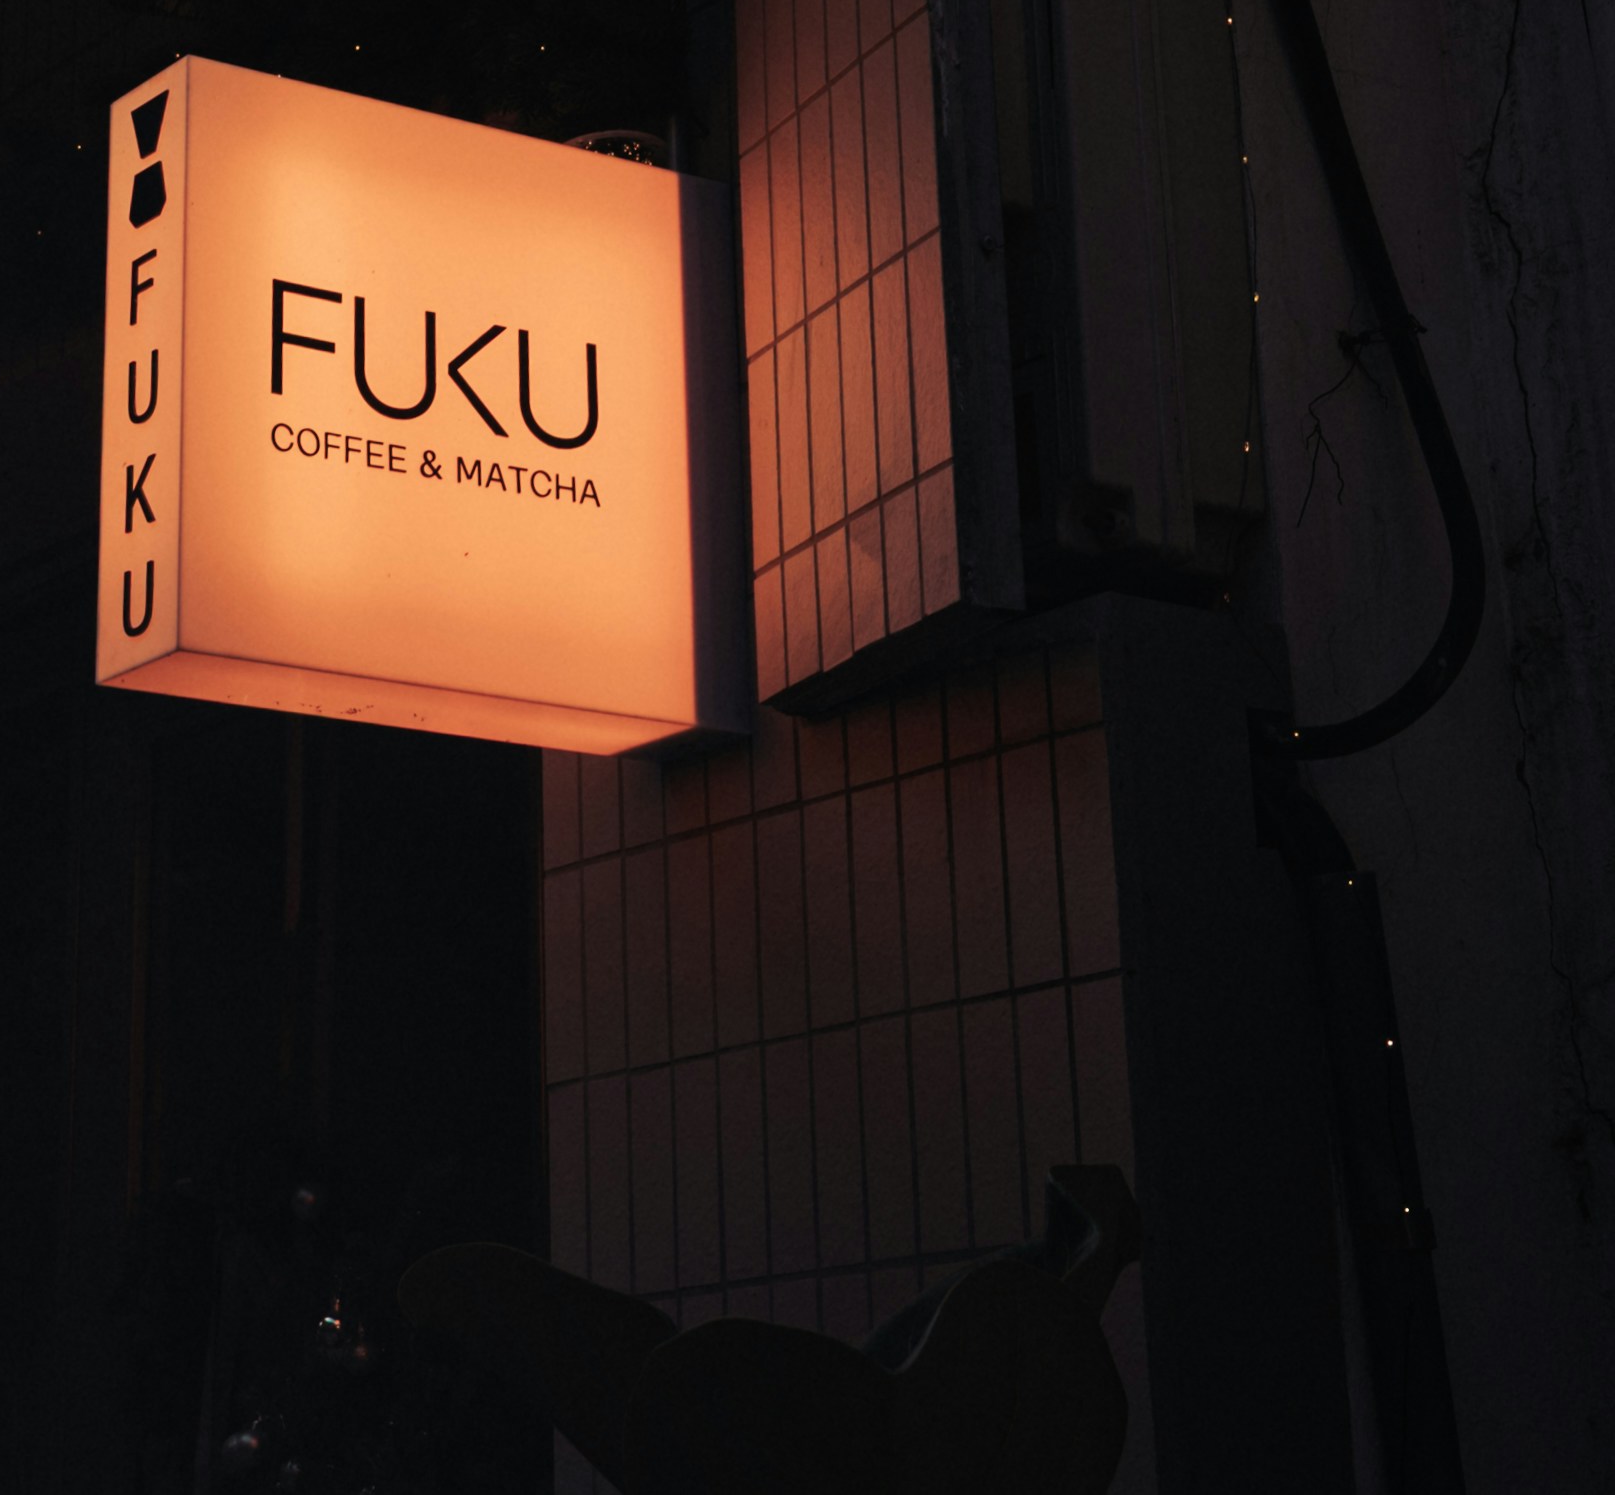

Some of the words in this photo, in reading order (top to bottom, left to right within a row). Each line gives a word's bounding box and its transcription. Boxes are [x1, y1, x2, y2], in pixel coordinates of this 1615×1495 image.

[122, 248, 159, 638] FUKU
[270, 278, 600, 450] FUKU
[270, 422, 408, 474] COFFEE
[419, 449, 443, 480] &
[456, 456, 602, 508] MATCHA
